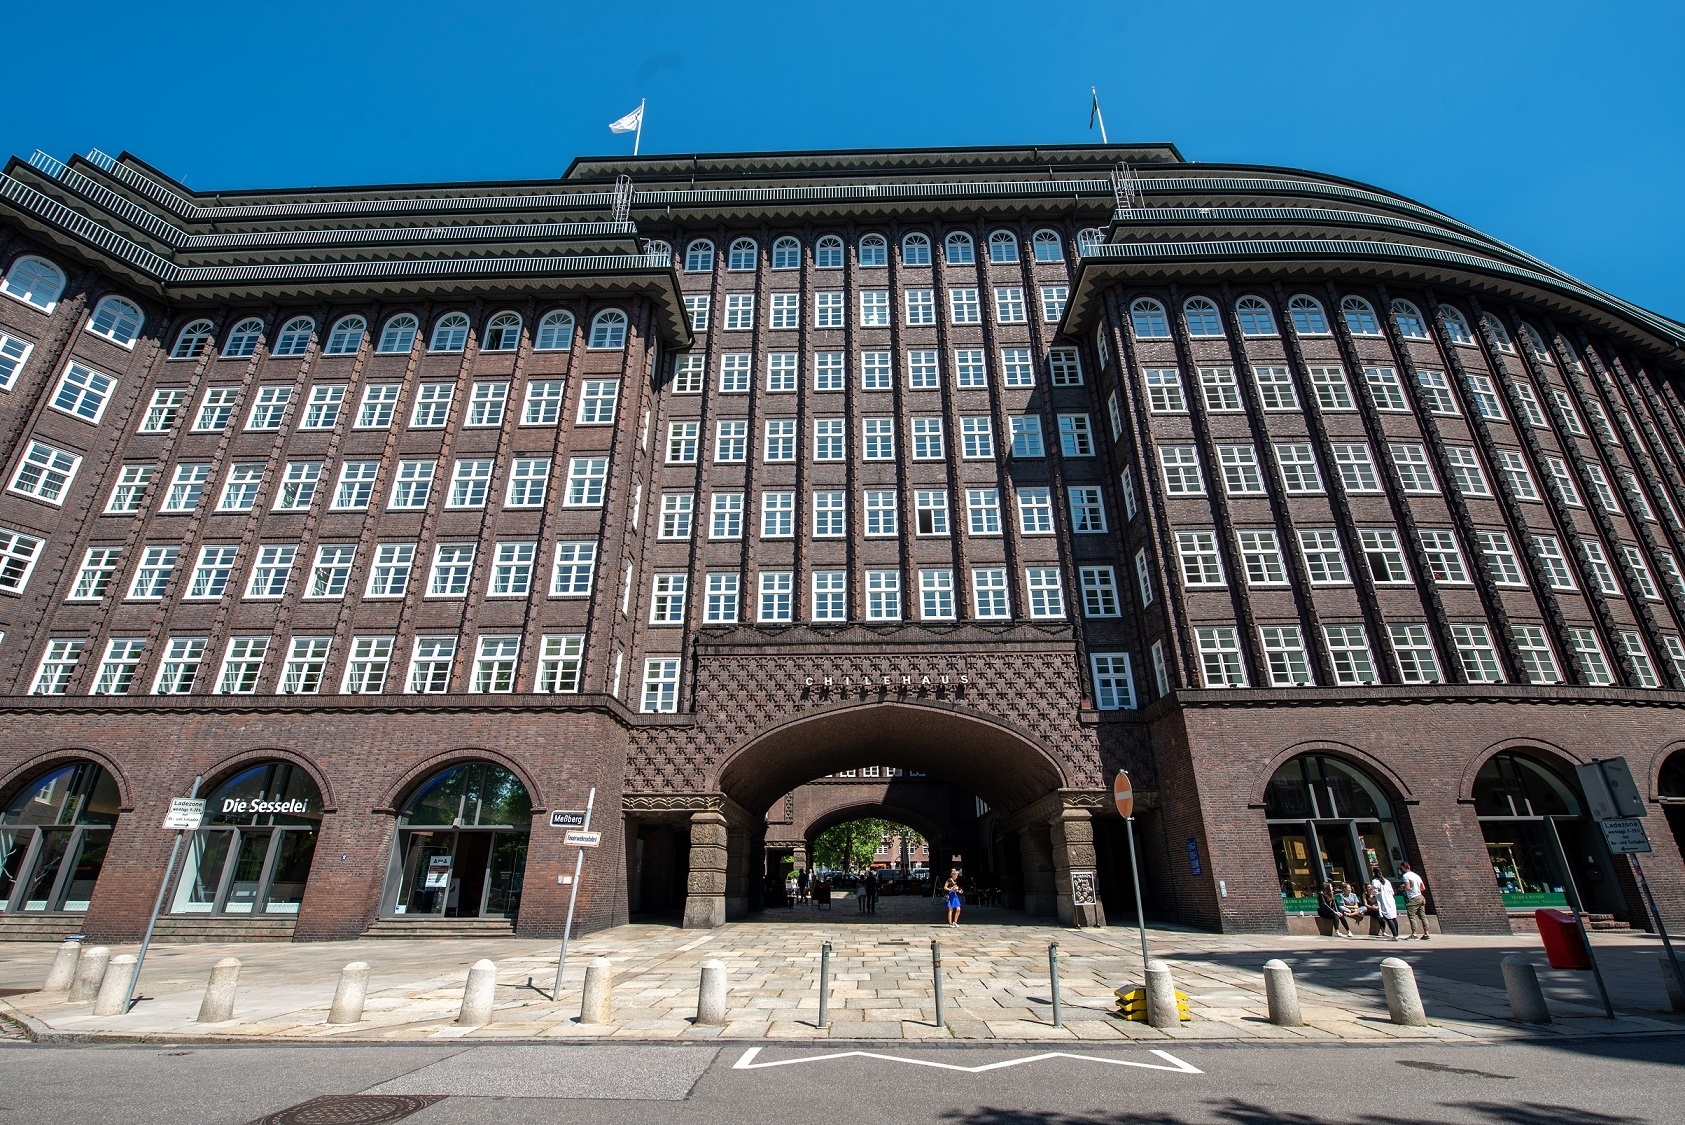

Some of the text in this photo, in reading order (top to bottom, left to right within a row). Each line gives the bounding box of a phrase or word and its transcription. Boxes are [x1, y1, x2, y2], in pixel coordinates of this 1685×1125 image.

[805, 675, 969, 686] CHILEHAUS
[222, 798, 309, 813] Die Sesselei
[554, 814, 582, 825] Meßberg
[1604, 821, 1638, 829] Ladezone
